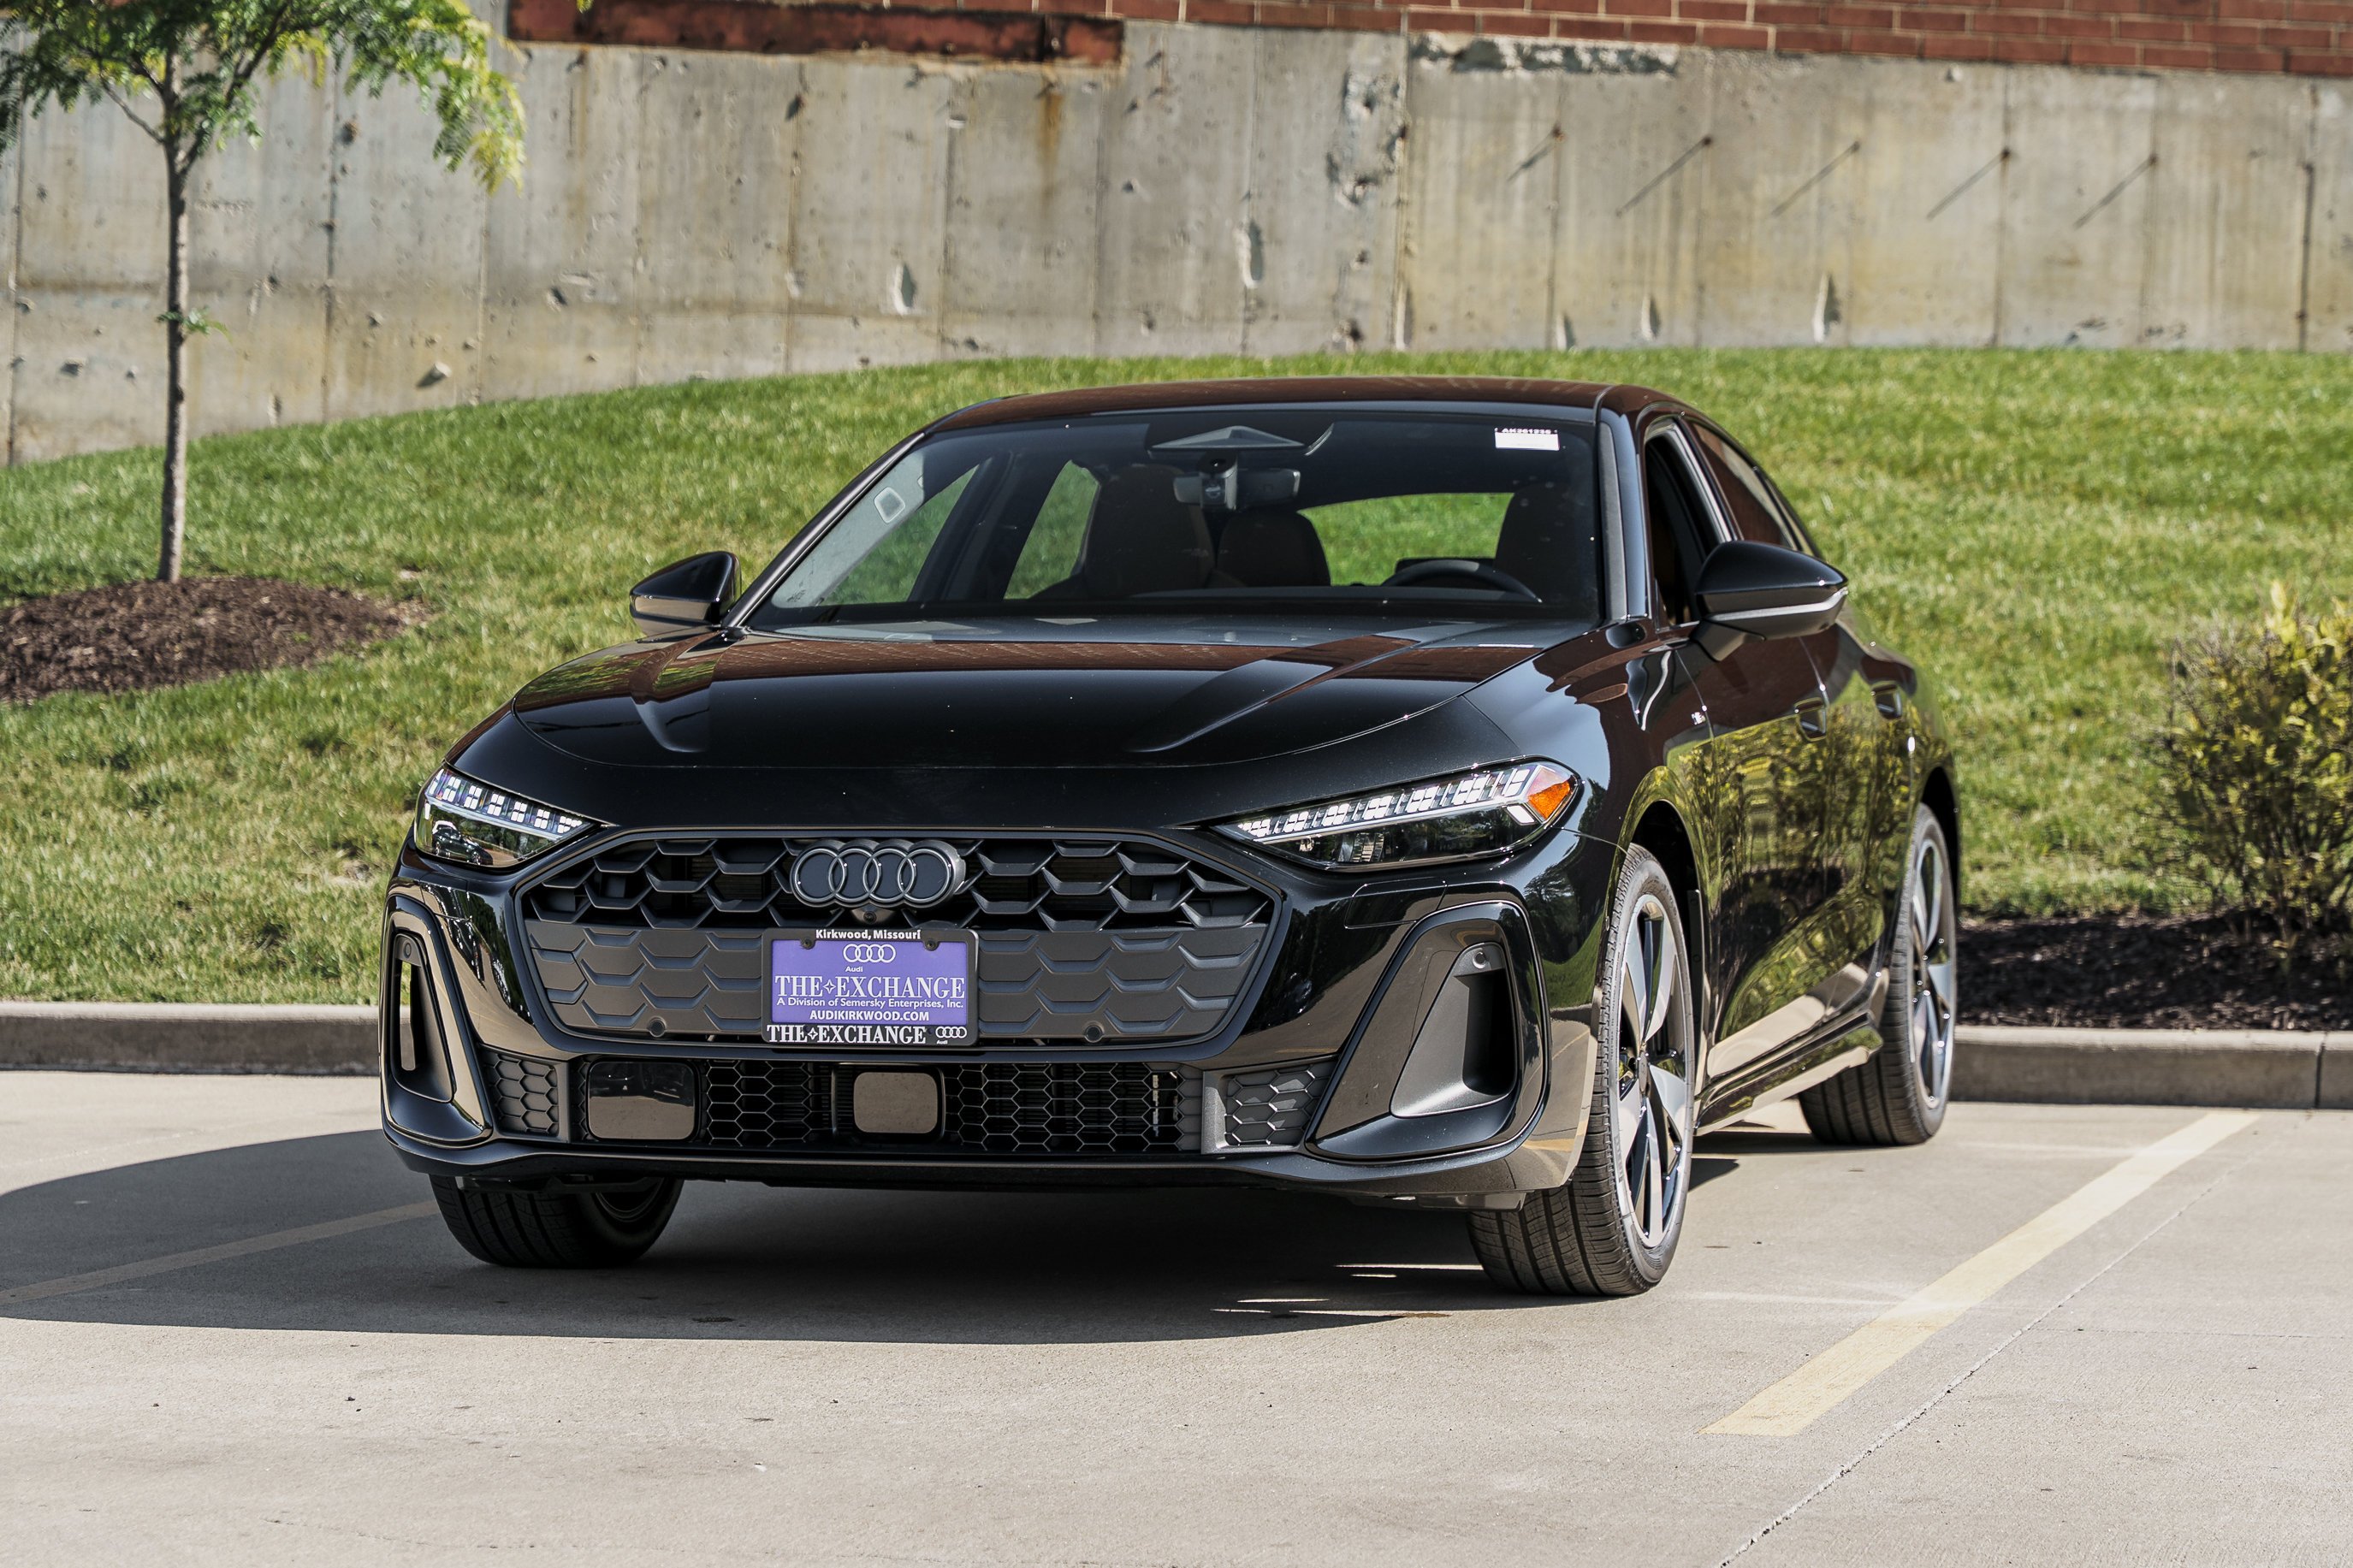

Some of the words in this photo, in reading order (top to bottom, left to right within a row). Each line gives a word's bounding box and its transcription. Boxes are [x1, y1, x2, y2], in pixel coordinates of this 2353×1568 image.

[815, 929, 872, 940] Kirkwood,
[873, 929, 922, 940] Missouri
[774, 975, 823, 997] THE
[834, 976, 965, 999] EXCHANGE
[776, 997, 786, 1006] A
[788, 997, 826, 1007] Division
[828, 997, 839, 1007] of
[840, 998, 886, 1009] Semersky
[888, 999, 944, 1009] Enterprises,
[946, 999, 964, 1009] Inc.
[809, 1009, 930, 1021] AUDIKIRKWOOD.COM
[767, 1024, 808, 1044] THE
[816, 1025, 927, 1044] EXCHANGE
